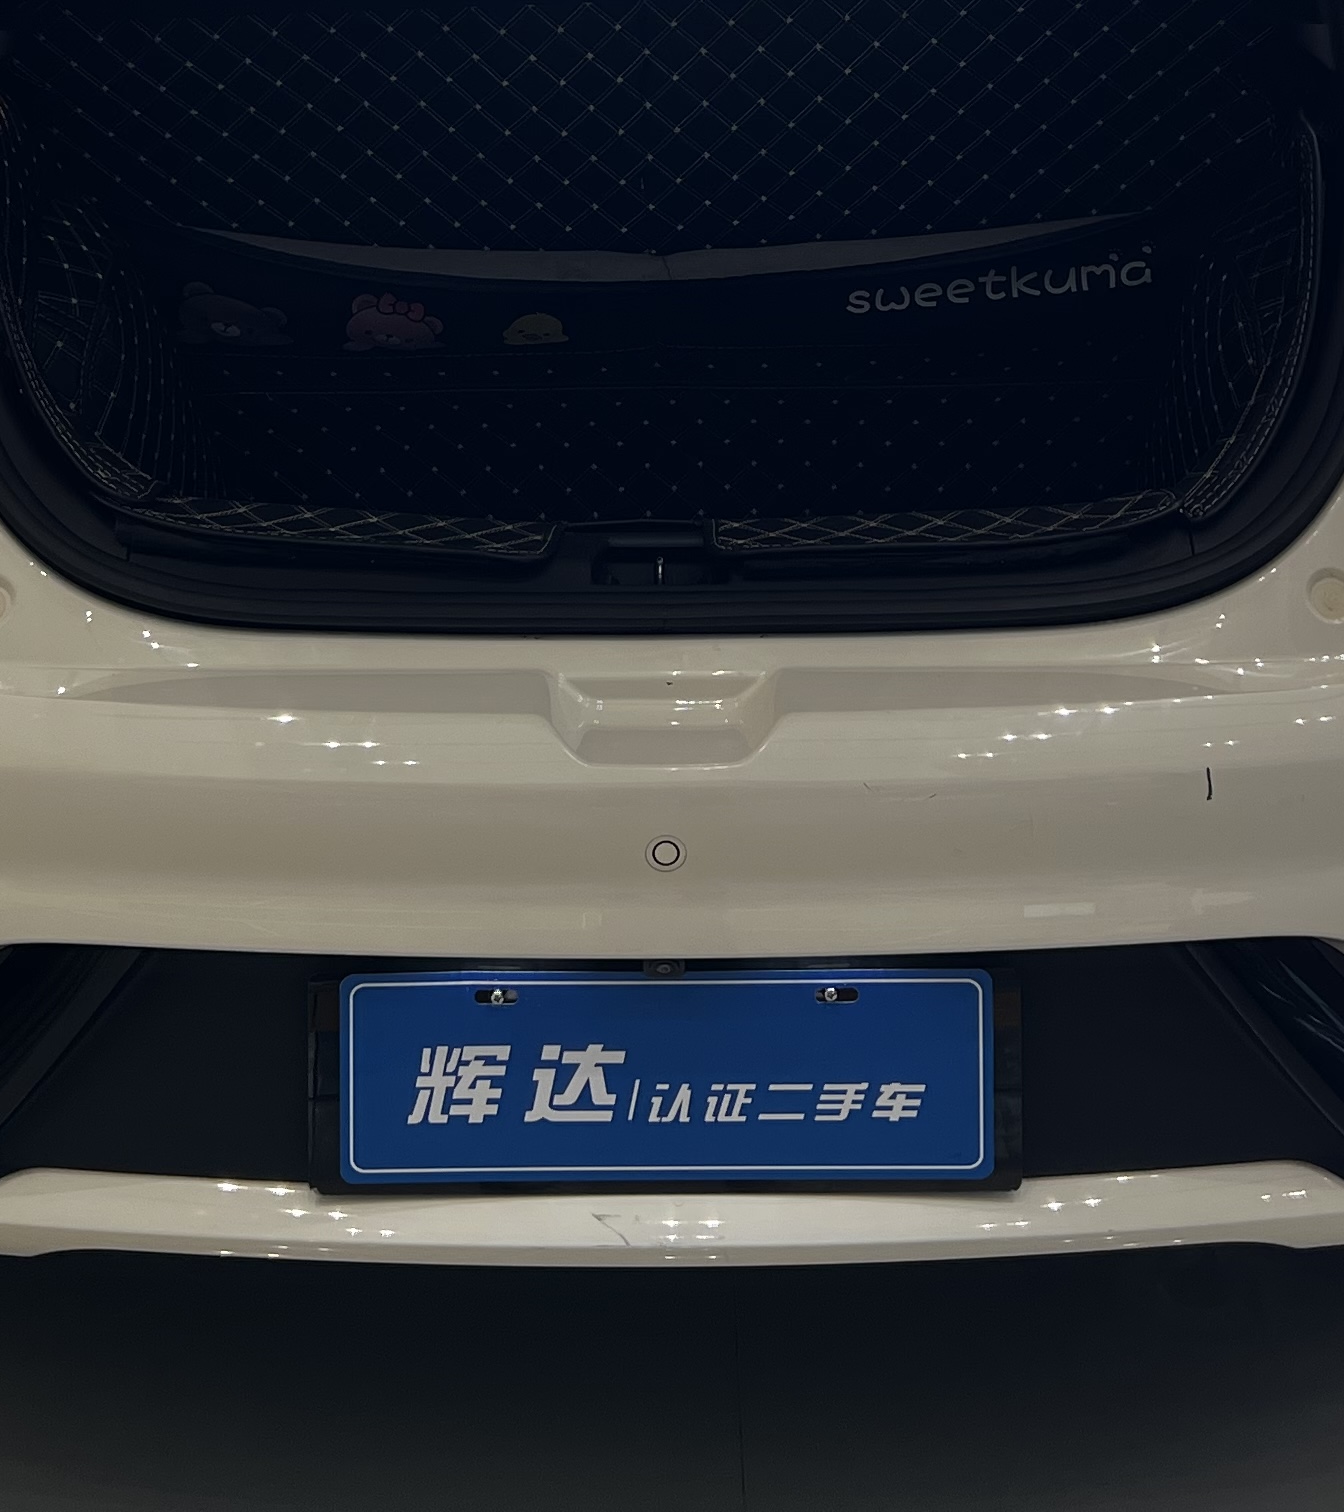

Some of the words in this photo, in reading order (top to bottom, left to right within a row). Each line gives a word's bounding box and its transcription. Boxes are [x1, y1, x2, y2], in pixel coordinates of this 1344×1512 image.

[846, 260, 1152, 314] sweetkuma
[407, 1043, 626, 1125] 辉达
[647, 1080, 926, 1124] 认证二手车
